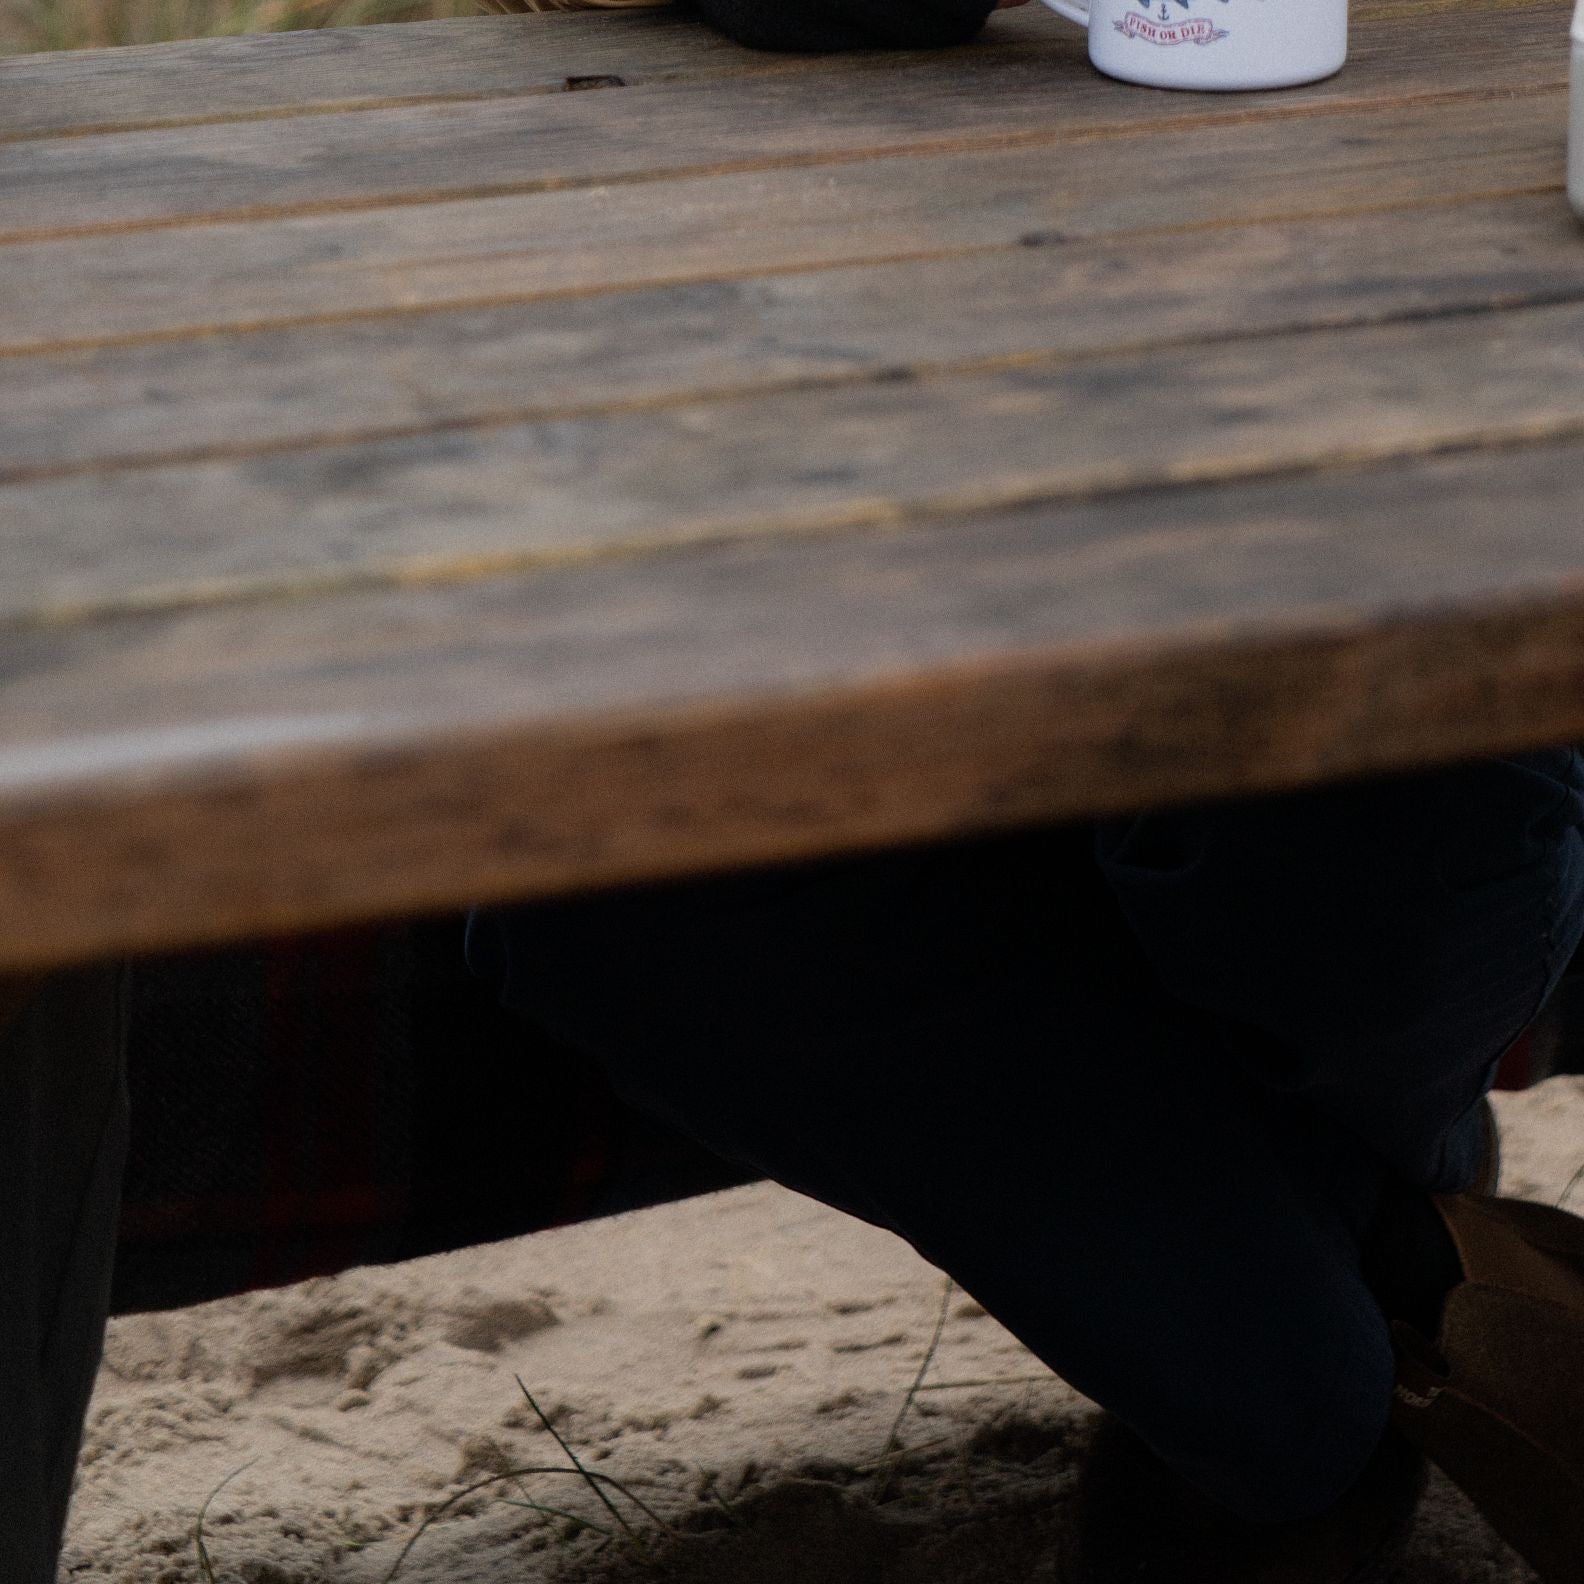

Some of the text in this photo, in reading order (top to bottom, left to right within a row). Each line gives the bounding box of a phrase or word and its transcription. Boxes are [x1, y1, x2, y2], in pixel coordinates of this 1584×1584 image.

[1129, 16, 1205, 40] FISH OR DIE
